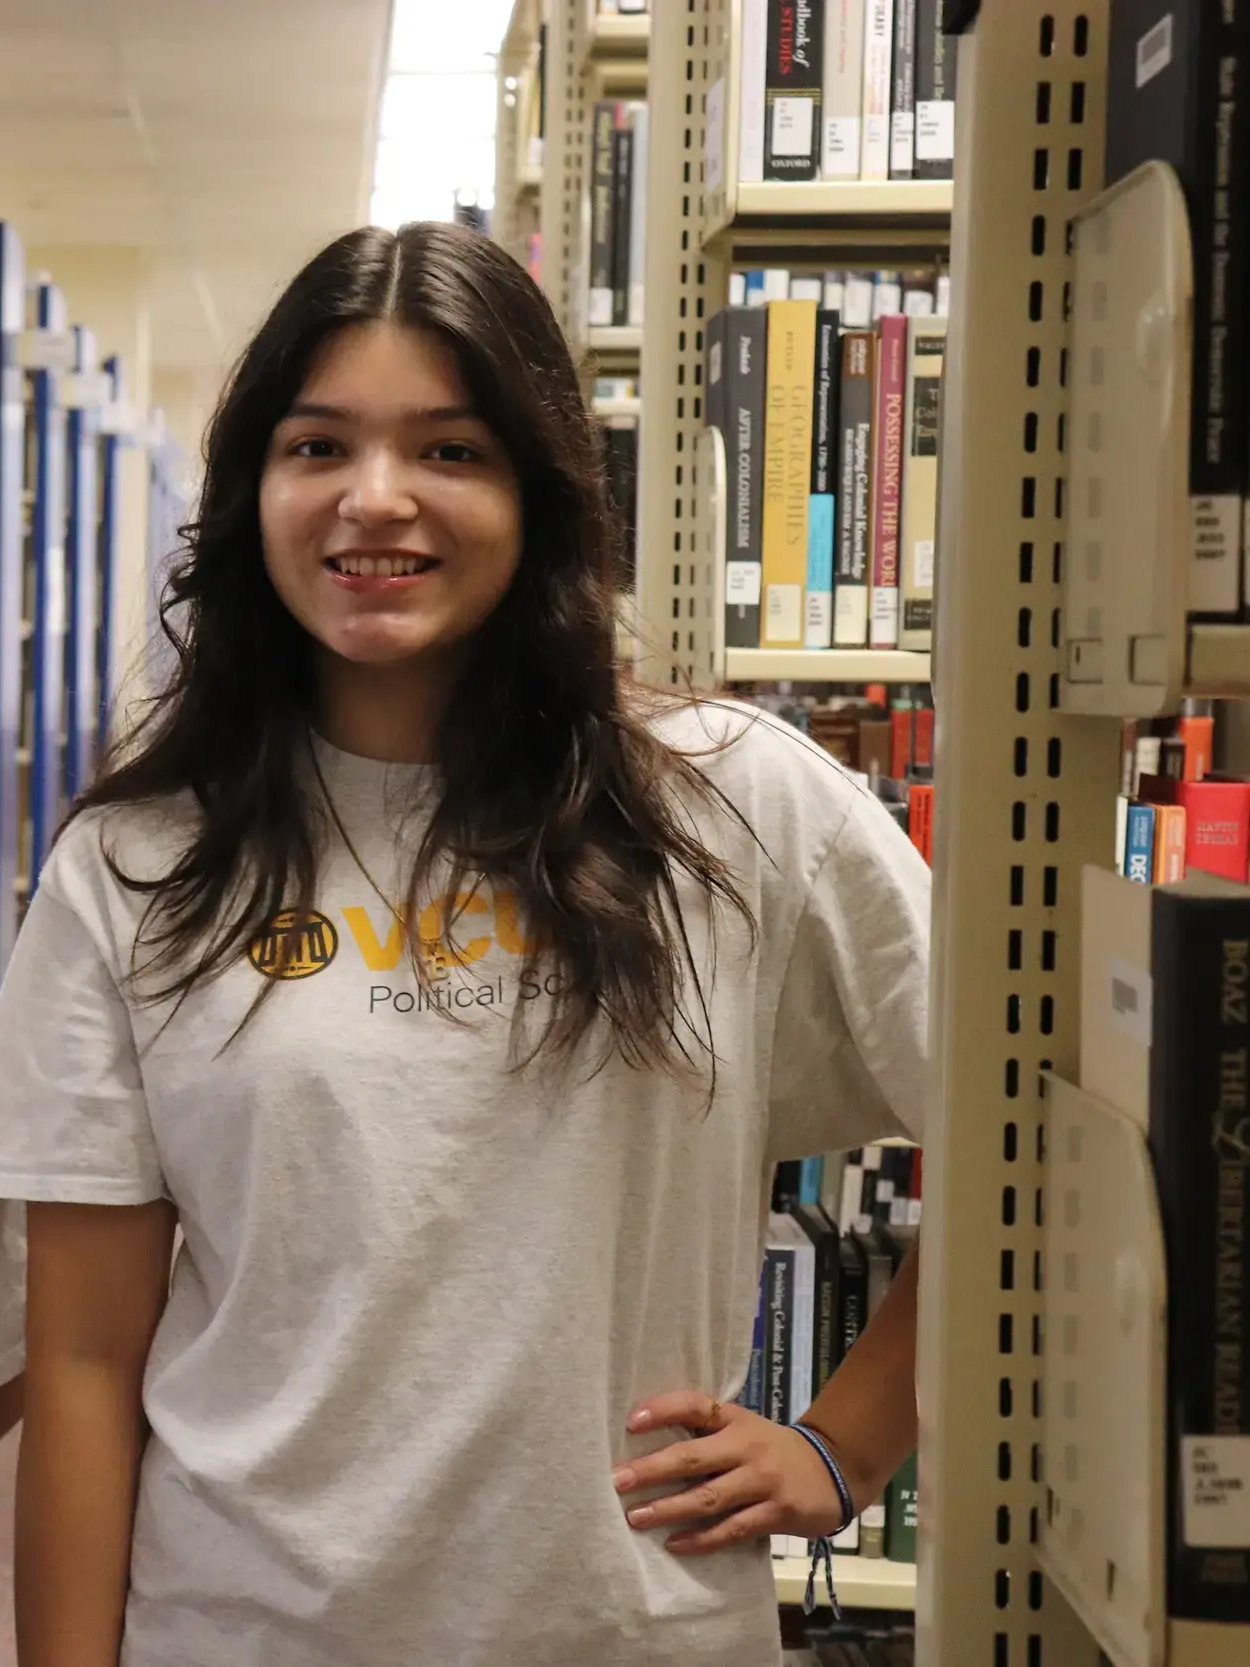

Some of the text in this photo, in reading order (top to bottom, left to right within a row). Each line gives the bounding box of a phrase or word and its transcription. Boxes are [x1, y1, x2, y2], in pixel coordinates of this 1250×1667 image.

[778, 6, 794, 75] STUDIES
[791, 0, 812, 68] ndbook of
[1213, 221, 1230, 247] the
[1214, 189, 1230, 220] and
[738, 406, 751, 451] AFTER
[766, 385, 786, 504] OF EMPIRE
[883, 392, 902, 496] POSSESSING
[787, 385, 809, 546] GEOGRAPHIES
[737, 452, 751, 548] COLONIALISM
[851, 423, 870, 580] Engaging Colonial Knowledge
[881, 499, 898, 536] THE
[880, 539, 897, 587] WORL
[1129, 853, 1148, 884] DEC
[369, 968, 565, 1014] Political Sc
[1212, 938, 1250, 1436] BOAZ THE LIBERTARIAN READE
[769, 1262, 787, 1424] Revisiting Colonial & Post-Coloni
